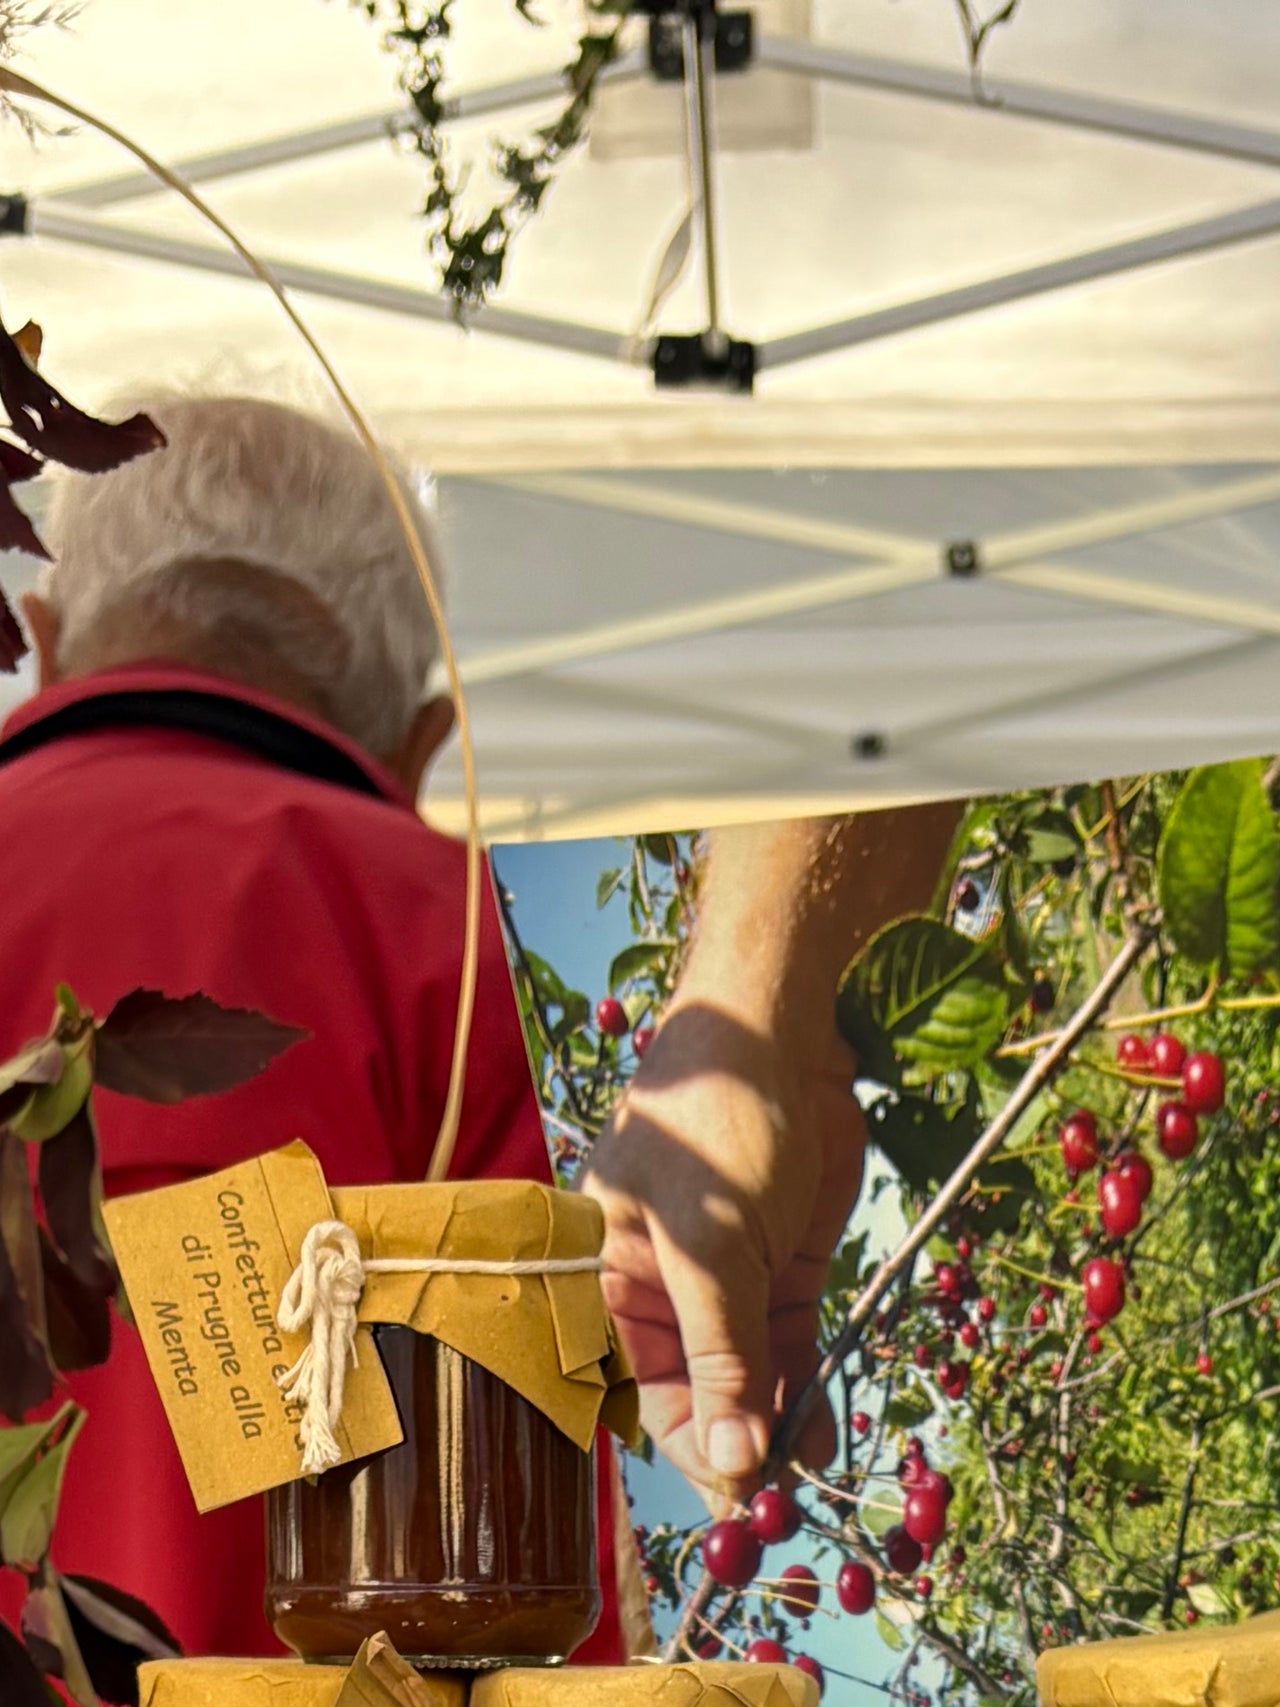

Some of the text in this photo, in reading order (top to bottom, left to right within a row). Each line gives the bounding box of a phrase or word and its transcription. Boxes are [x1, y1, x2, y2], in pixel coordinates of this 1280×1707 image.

[151, 1301, 198, 1397] Menta
[181, 1235, 265, 1440] di Prugne alla
[217, 1190, 282, 1355] Confettura
